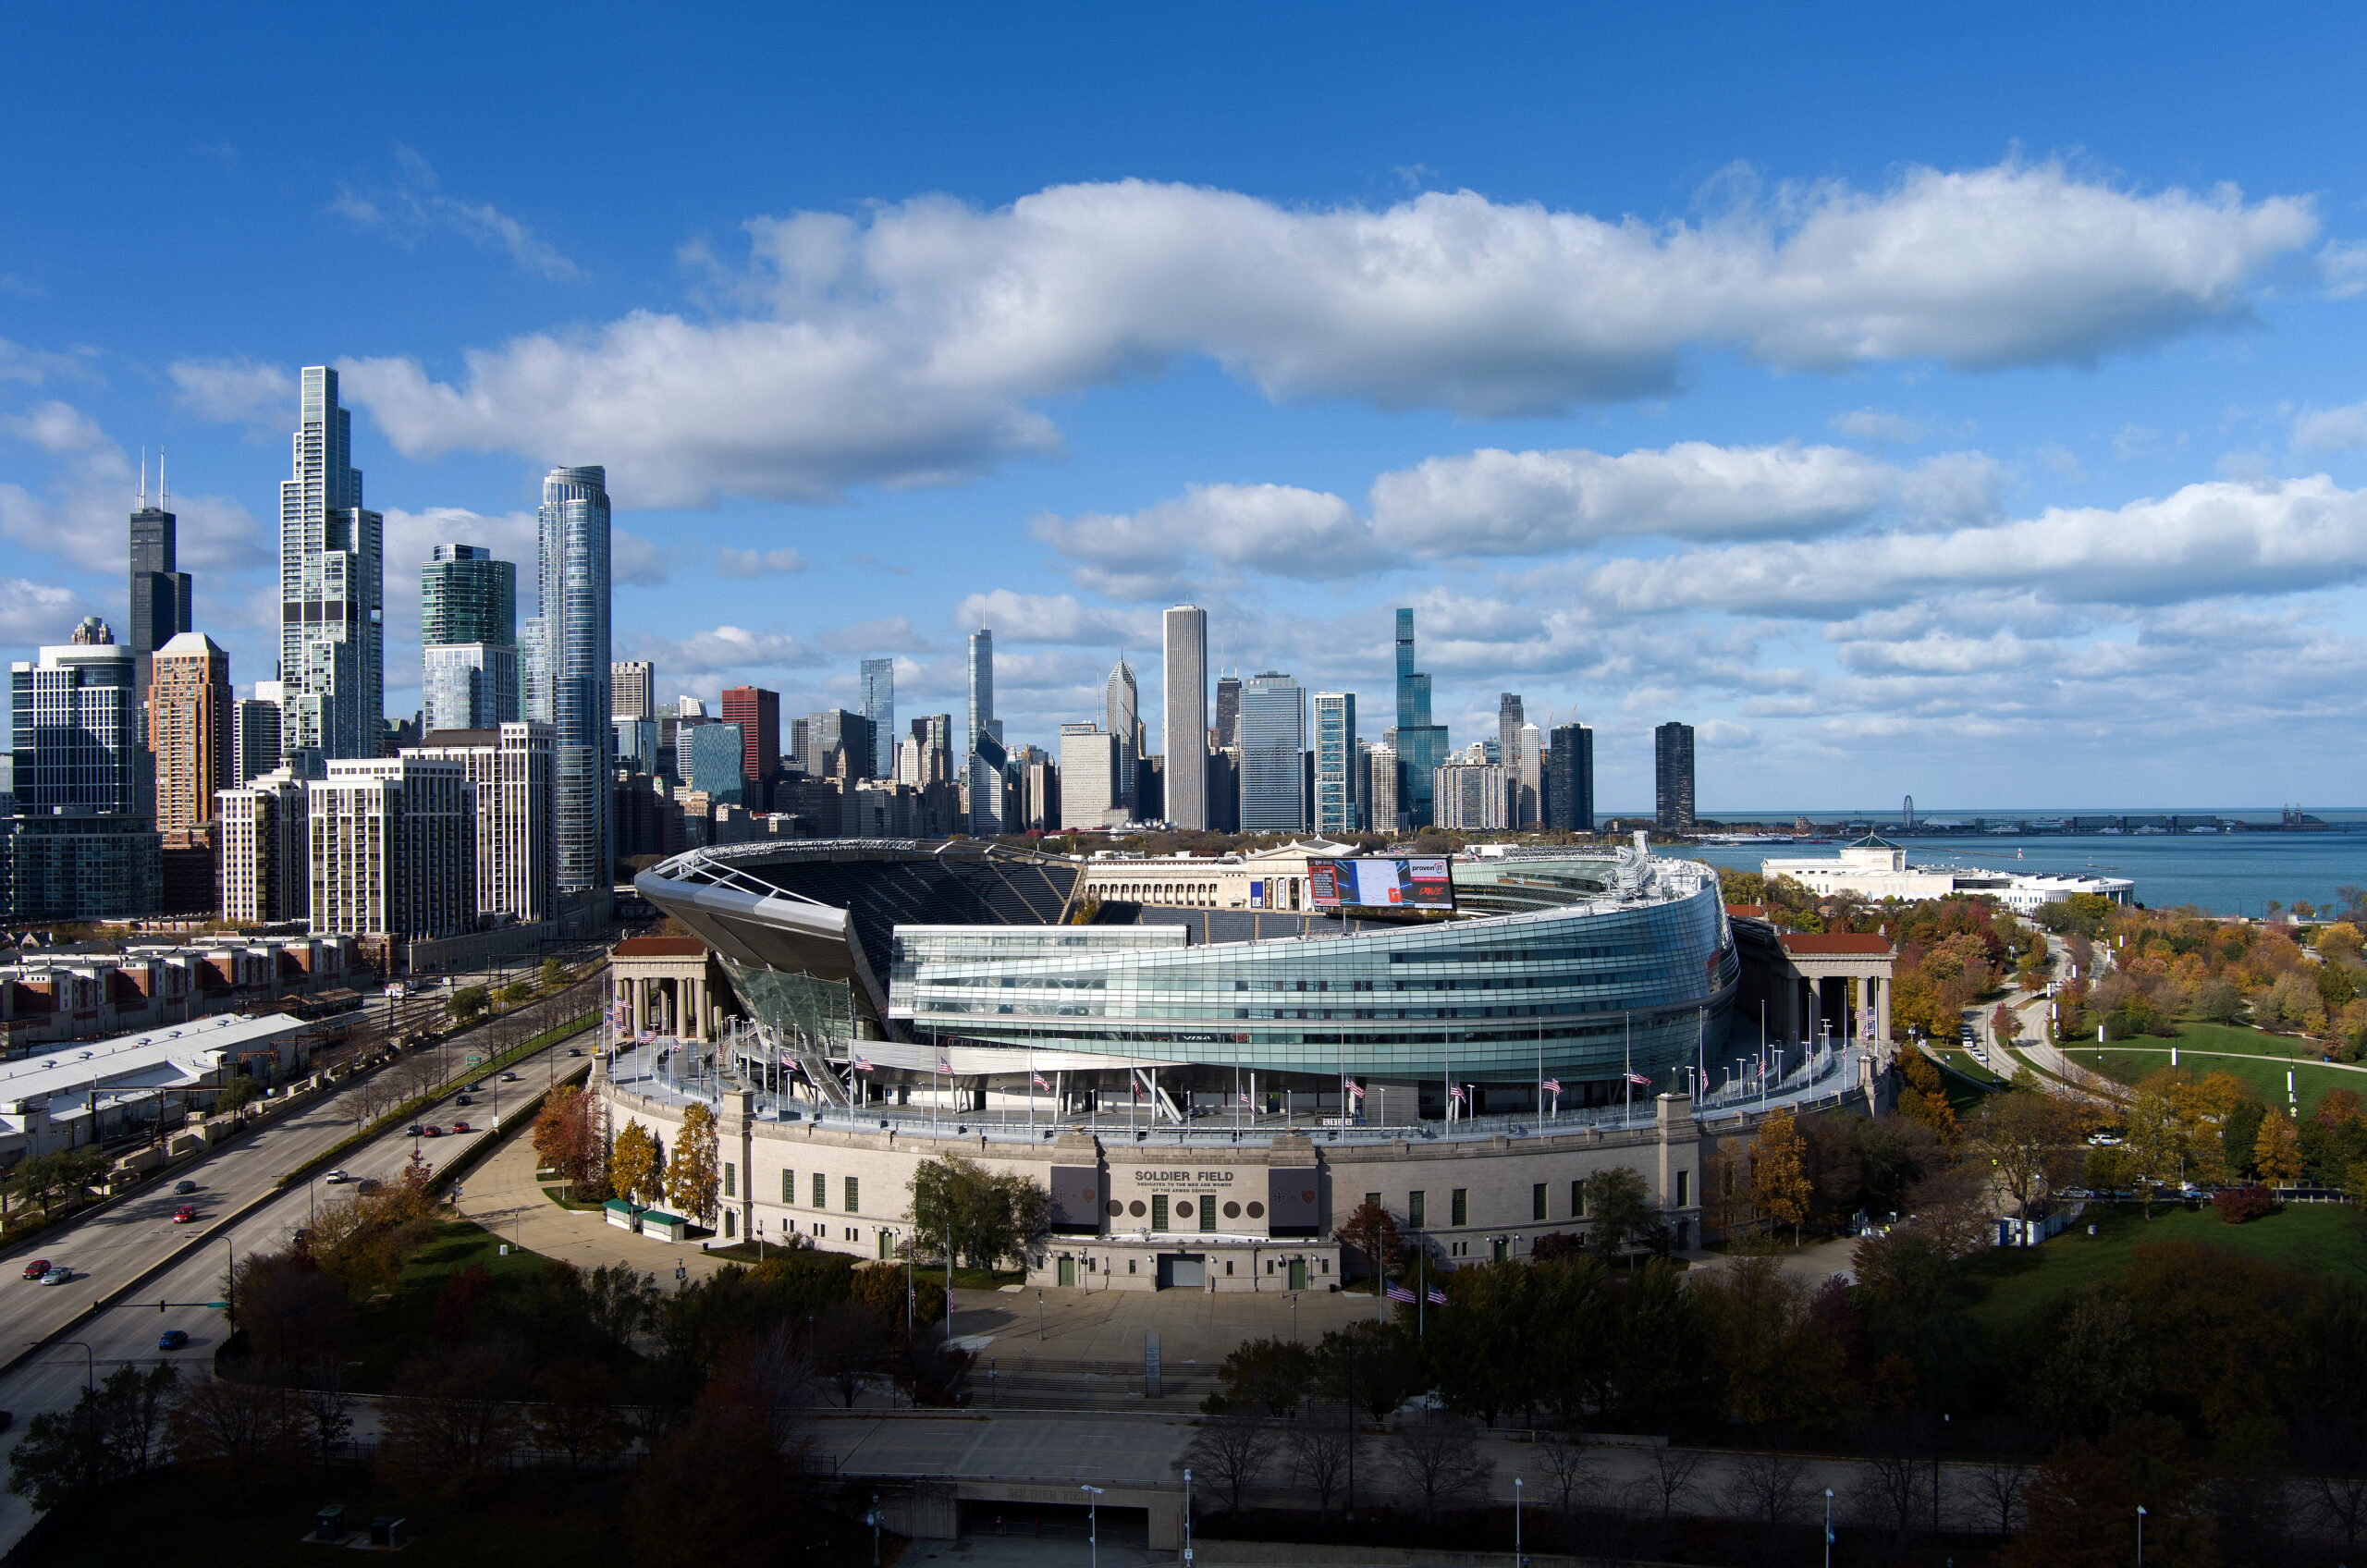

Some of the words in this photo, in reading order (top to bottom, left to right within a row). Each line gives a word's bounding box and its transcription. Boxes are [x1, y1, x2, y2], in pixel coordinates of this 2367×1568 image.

[1135, 1170, 1190, 1181] SOLDIER
[1198, 1171, 1234, 1181] FIELD
[1007, 1487, 1056, 1501] SOLDIER
